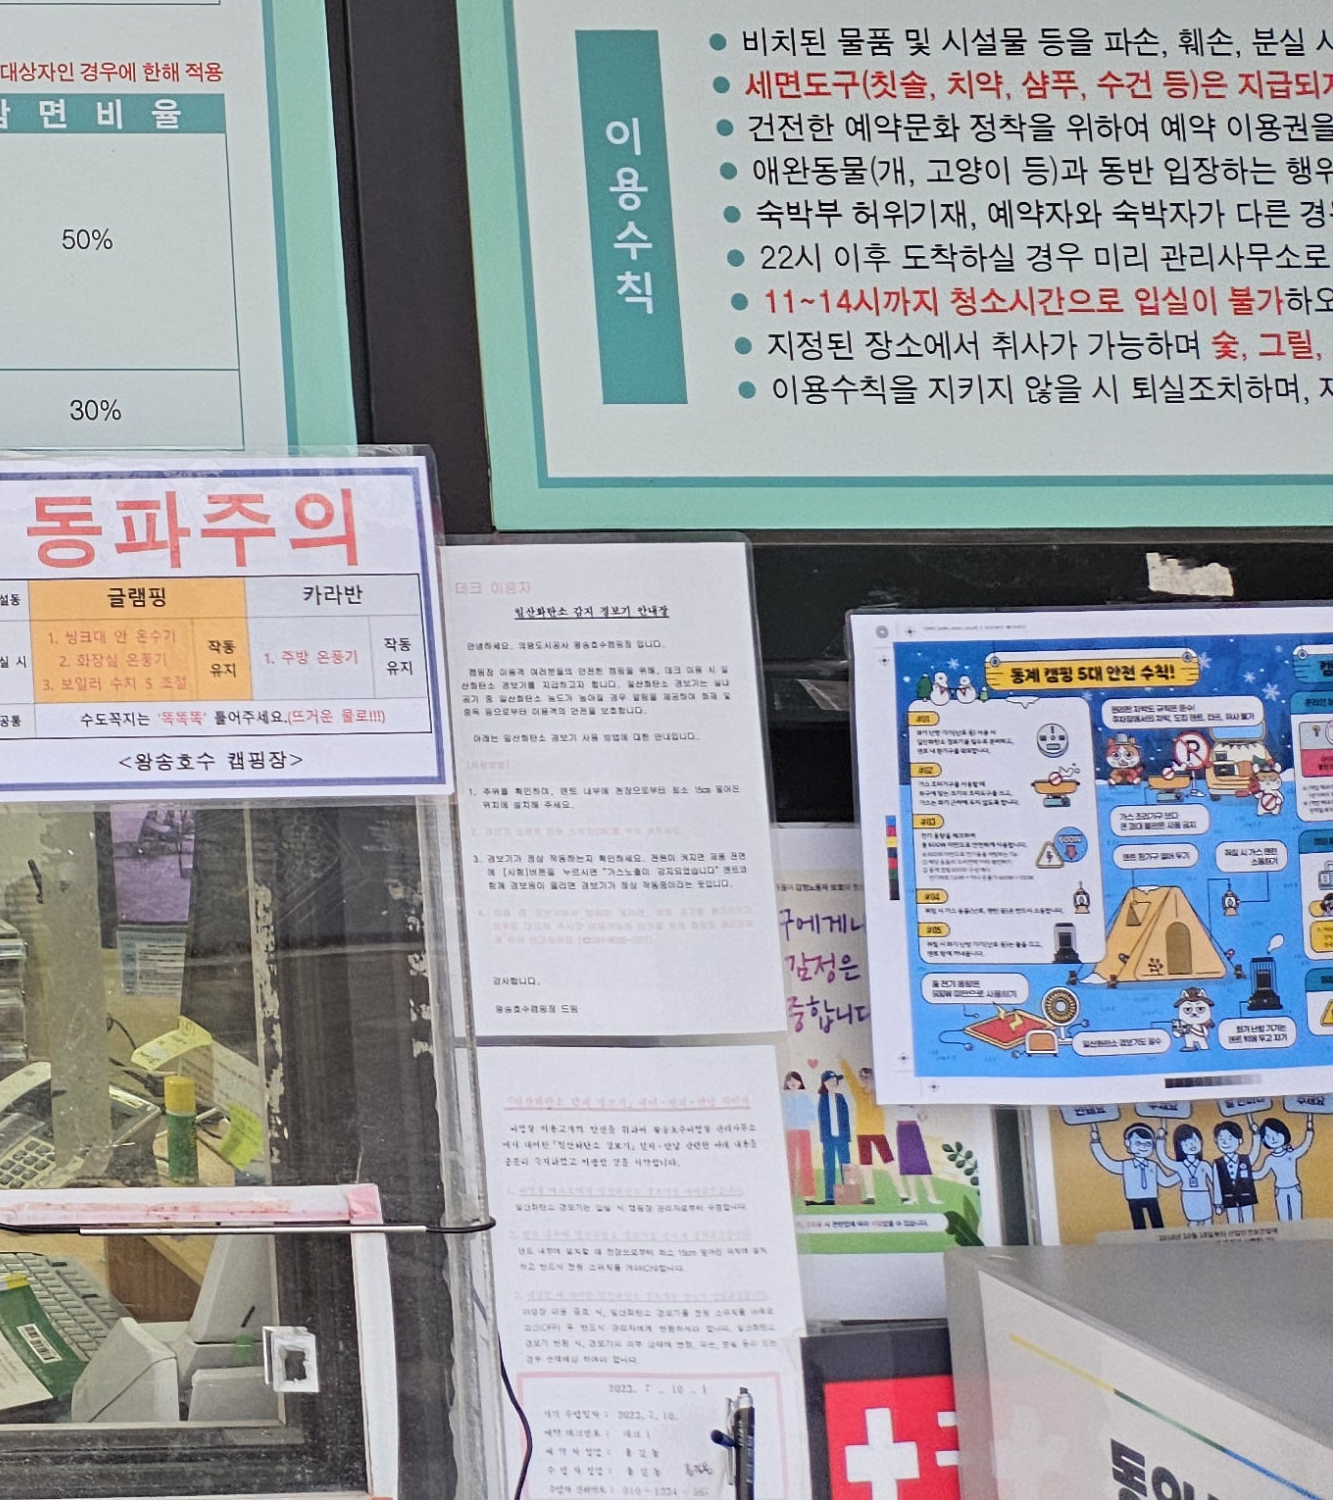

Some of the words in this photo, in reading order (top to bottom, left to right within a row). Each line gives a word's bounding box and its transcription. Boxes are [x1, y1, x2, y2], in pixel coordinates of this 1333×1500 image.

[743, 28, 826, 56] 비치된
[942, 28, 1027, 56] 시설물
[749, 113, 834, 141] 건전한
[846, 113, 960, 142] 예약문화
[62, 229, 113, 250] 50%
[761, 243, 820, 272] 22시
[902, 243, 1014, 272] 도착하실
[766, 287, 938, 316] 11~14시까지
[950, 287, 1124, 316] 청소시간으로
[773, 375, 917, 405] 이용수칙을
[70, 399, 121, 421] 30%
[27, 488, 358, 568] 동파주의
[107, 588, 165, 608] 글램핑
[304, 585, 363, 605] 카라반
[384, 638, 411, 651] 작동
[387, 661, 413, 675] 유지
[1044, 667, 1073, 683] 캠핑
[1106, 666, 1135, 681] 안전
[0, 715, 21, 727] 공통
[81, 712, 150, 727] 수도꼭지는
